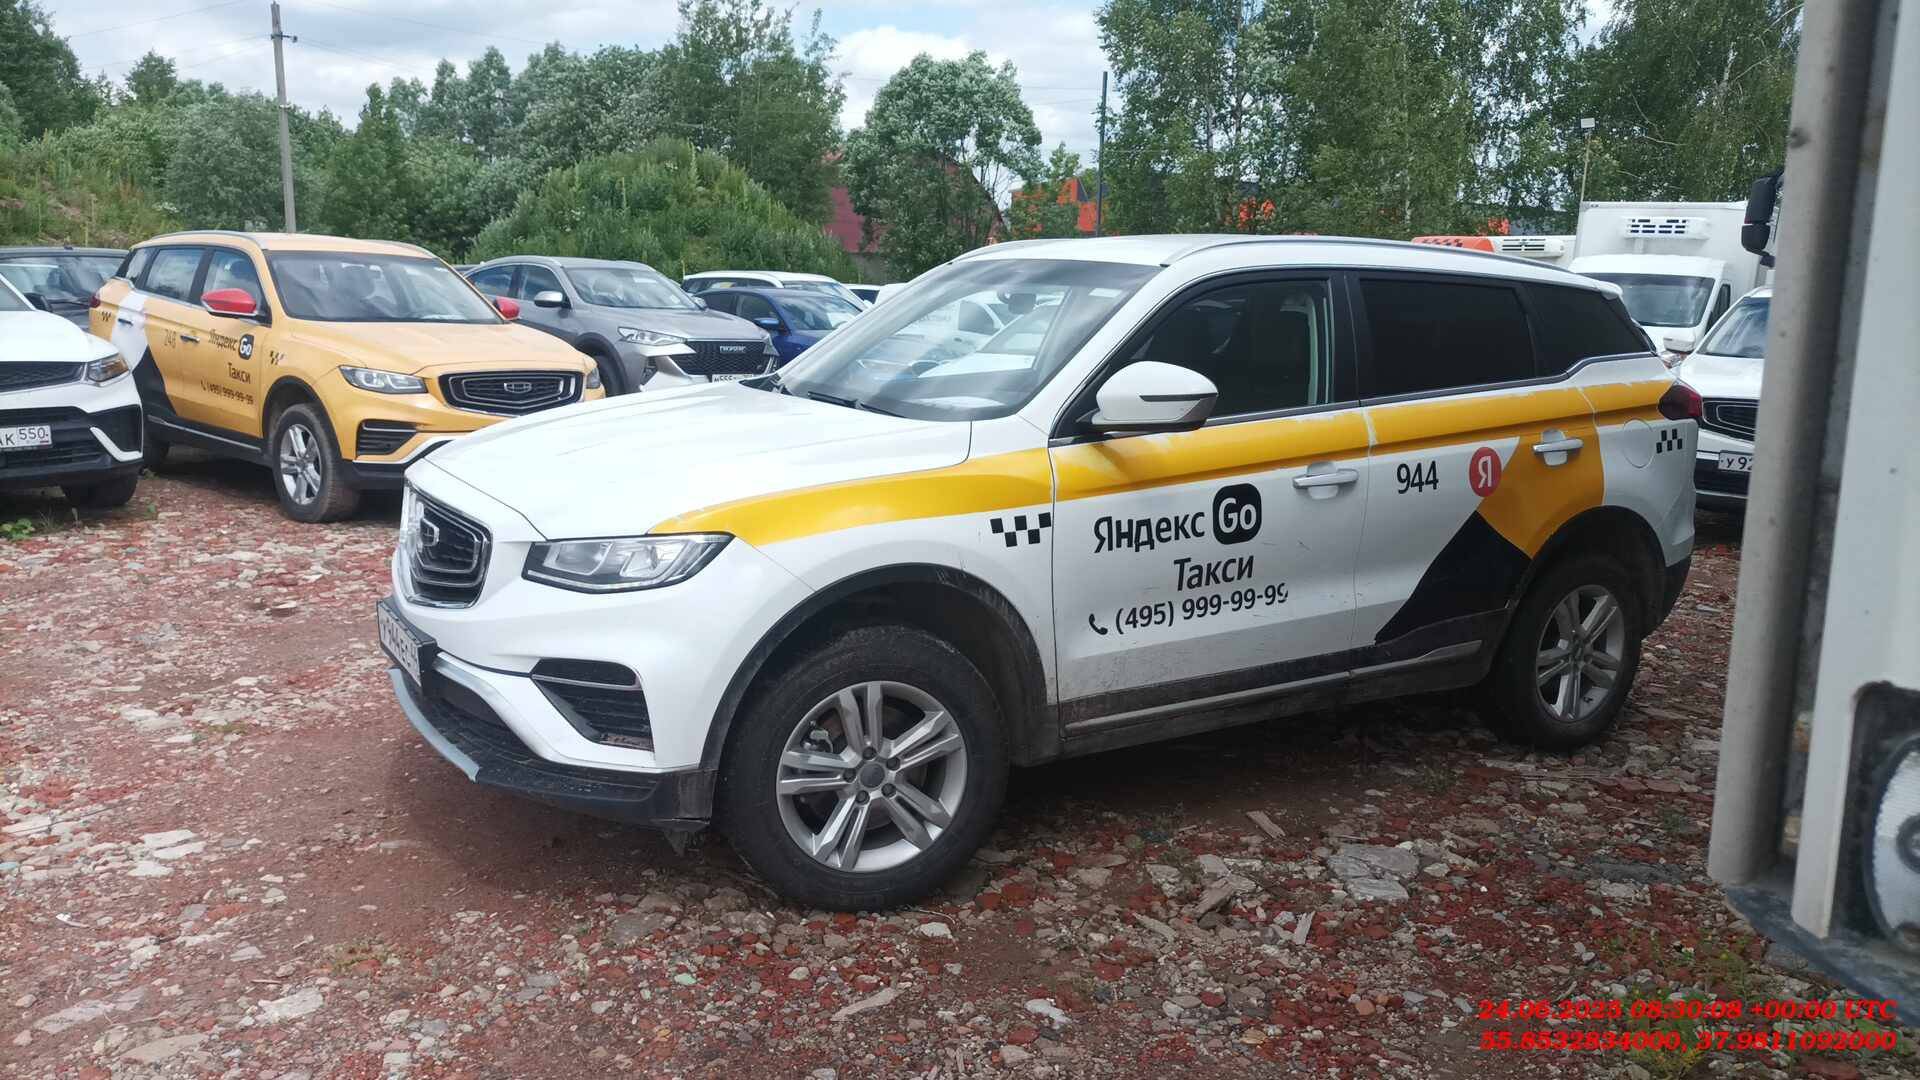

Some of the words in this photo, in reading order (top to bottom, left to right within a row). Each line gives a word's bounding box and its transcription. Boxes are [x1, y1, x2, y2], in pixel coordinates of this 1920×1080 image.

[227, 362, 251, 384] Такси
[18, 427, 46, 440] 550
[1396, 460, 1439, 494] 944
[1093, 511, 1205, 553] Яндекс
[1173, 555, 1254, 591] Такси
[1115, 601, 1174, 635] (495)
[1182, 582, 1288, 620] 999-99-99
